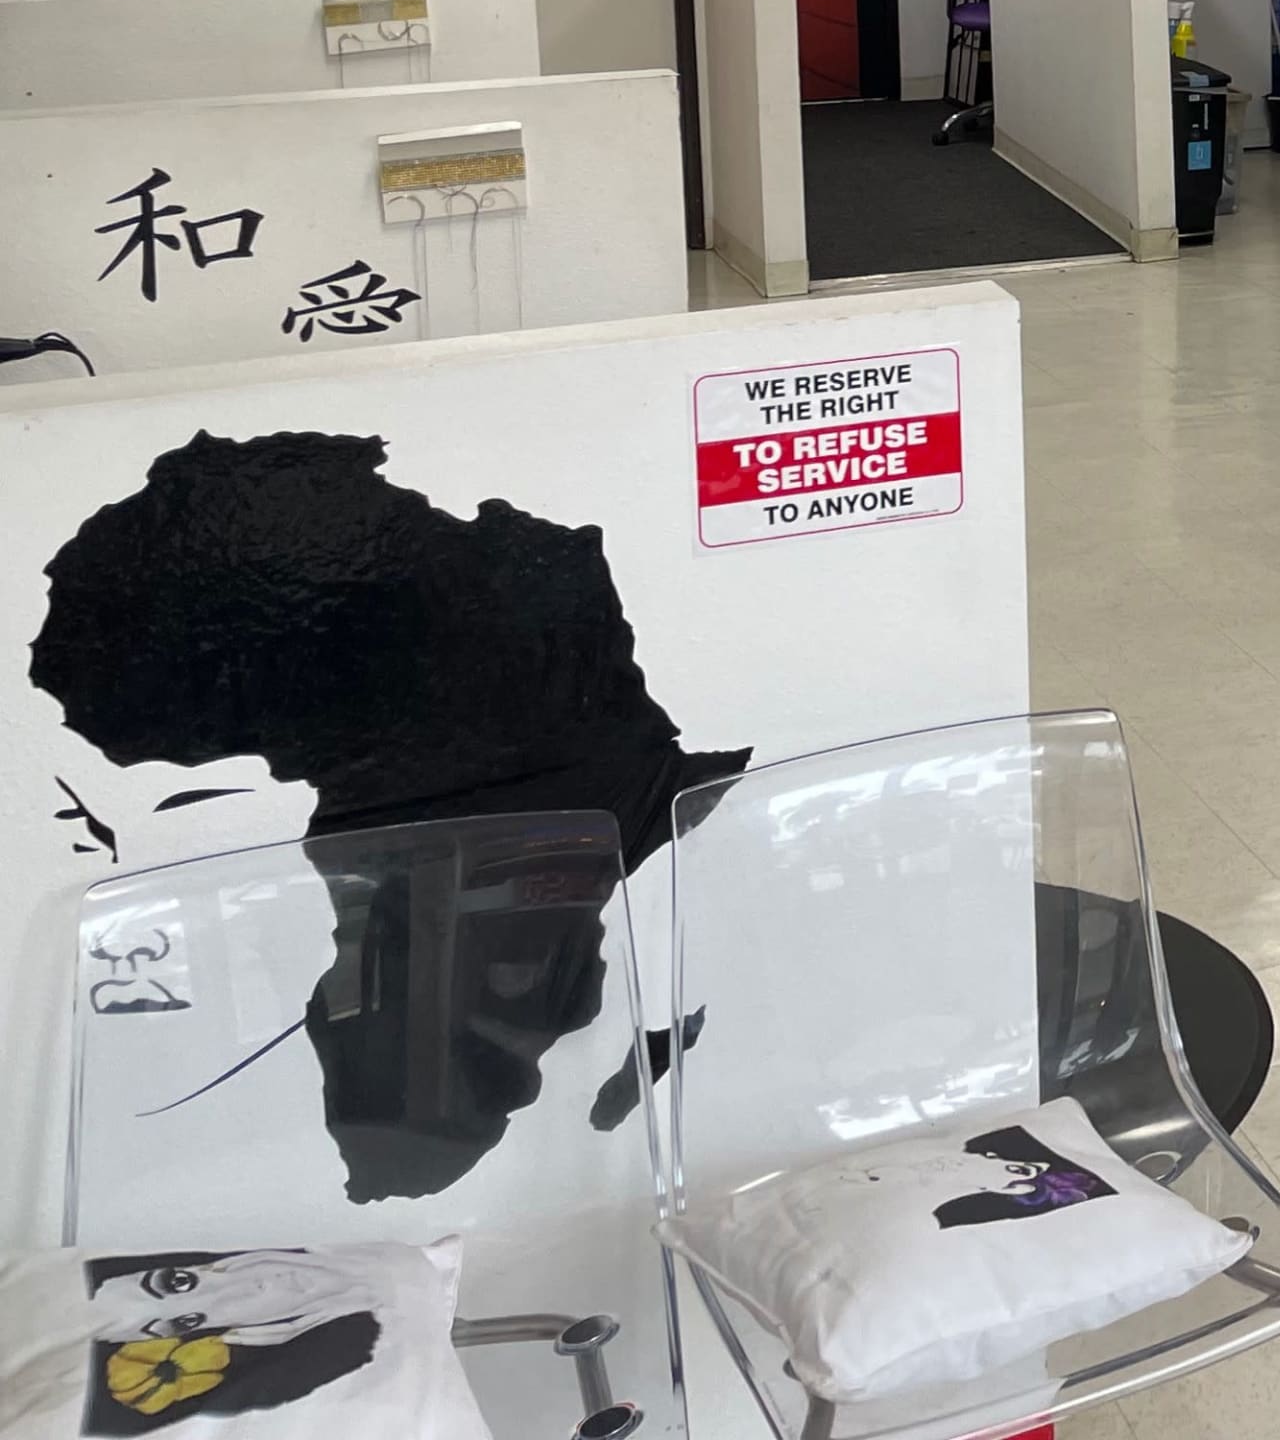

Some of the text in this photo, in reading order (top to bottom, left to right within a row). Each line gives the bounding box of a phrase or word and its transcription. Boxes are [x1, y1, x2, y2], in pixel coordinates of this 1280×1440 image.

[94, 167, 264, 303] 和
[745, 364, 912, 401] WE RESERVE
[760, 390, 899, 424] THE RIGHT
[733, 420, 928, 468] TO REFUSE
[757, 451, 908, 493] SERVICE
[763, 503, 799, 525] TO
[807, 487, 914, 520] ANYONE
